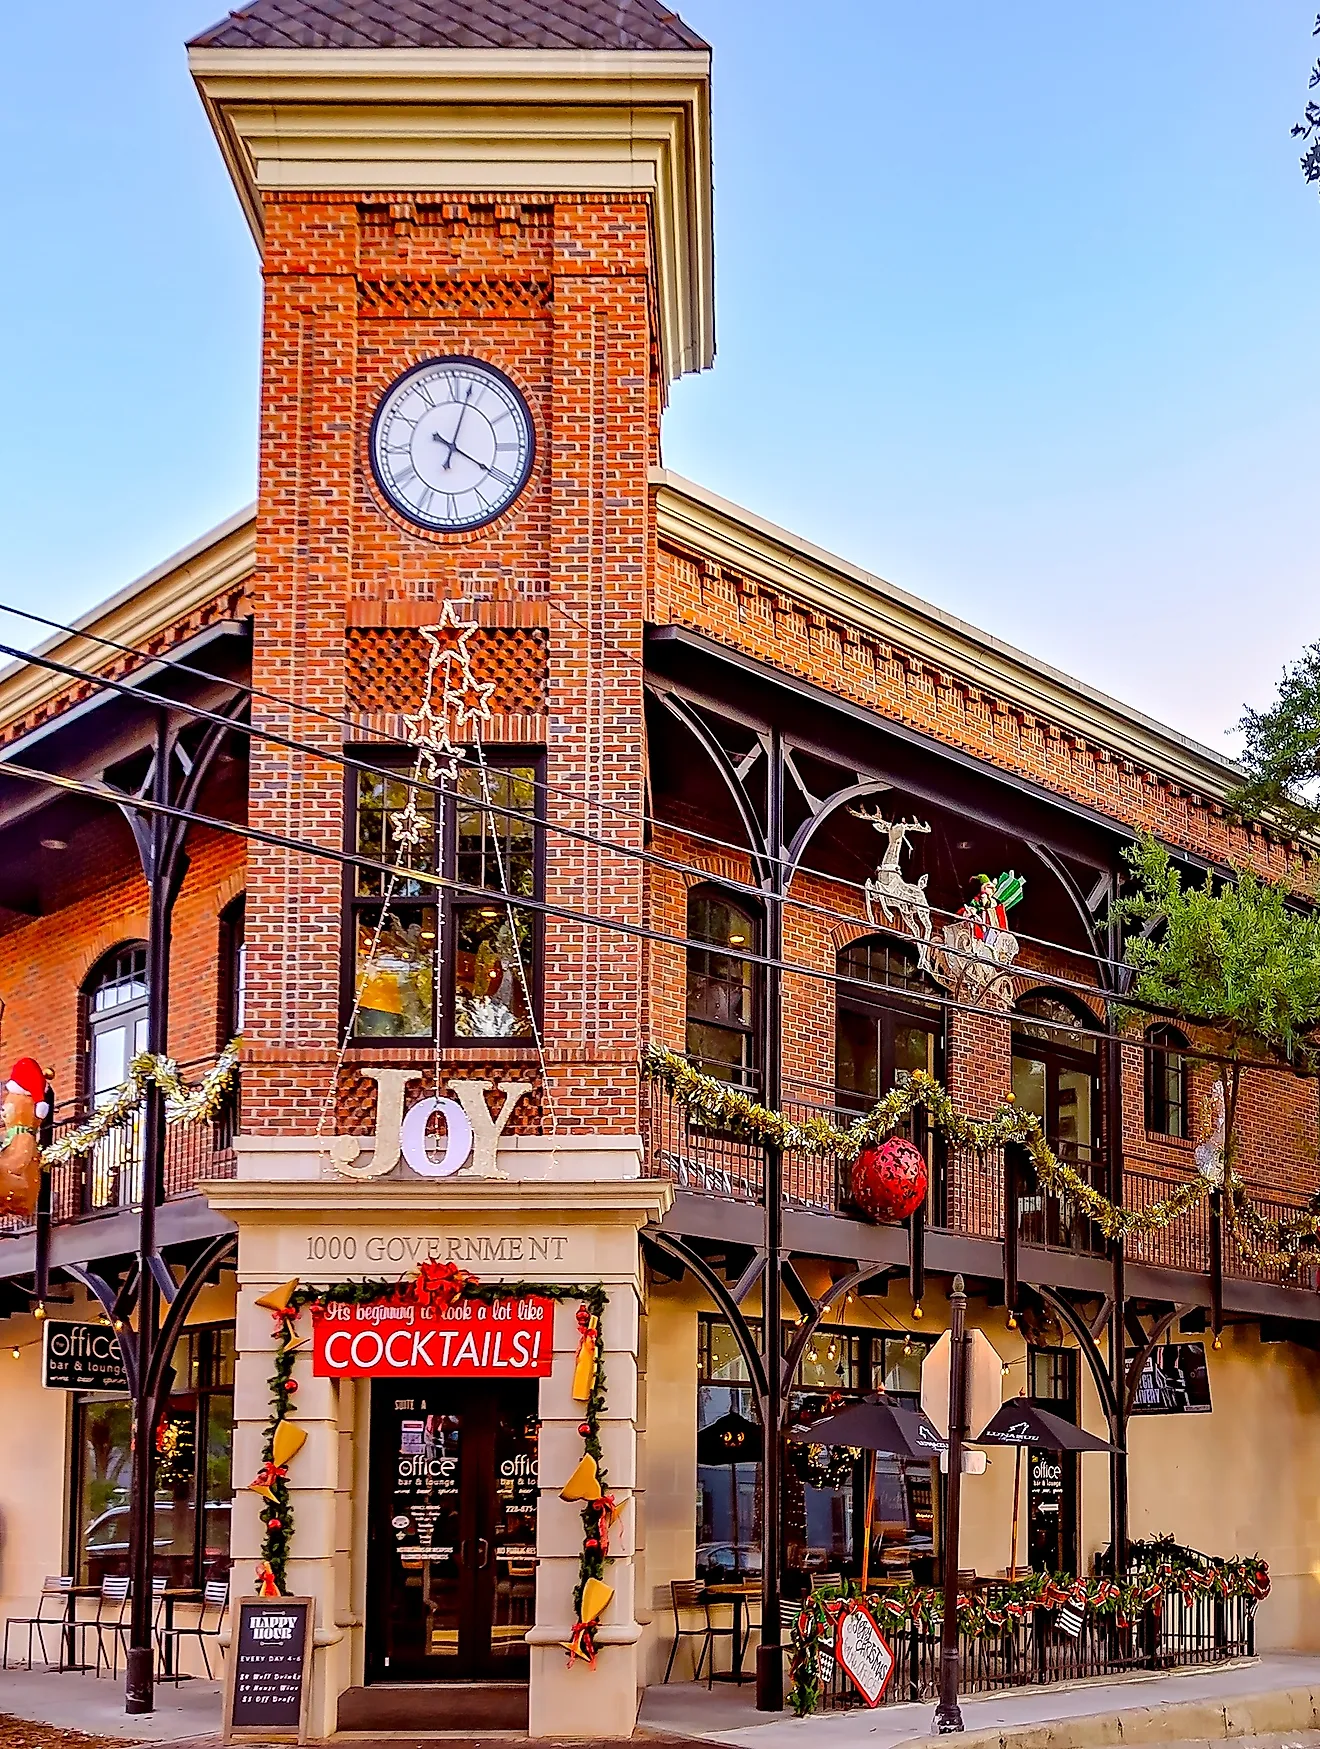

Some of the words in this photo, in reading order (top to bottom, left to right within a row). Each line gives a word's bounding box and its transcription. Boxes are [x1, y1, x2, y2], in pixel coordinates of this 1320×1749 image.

[330, 1067, 533, 1180] JOY
[306, 1236, 357, 1261] 1000
[365, 1236, 568, 1262] GOVERNMENT
[356, 1302, 415, 1326] beginning
[477, 1305, 487, 1320] a
[492, 1299, 512, 1320] lot
[517, 1298, 544, 1321] like
[51, 1326, 122, 1360] office
[324, 1330, 542, 1369] COCKTAILS!
[49, 1359, 69, 1370] bar
[74, 1361, 83, 1371] &
[88, 1362, 127, 1376] lounge
[394, 1399, 415, 1410] SUITE
[399, 1455, 456, 1476] office
[1033, 1461, 1062, 1480] office
[398, 1478, 413, 1486] bar
[425, 1478, 455, 1488] lounge
[249, 1616, 298, 1629] HAPPY
[253, 1628, 292, 1640] HOUR
[240, 1655, 266, 1663] EVERY
[268, 1655, 285, 1663] DAY
